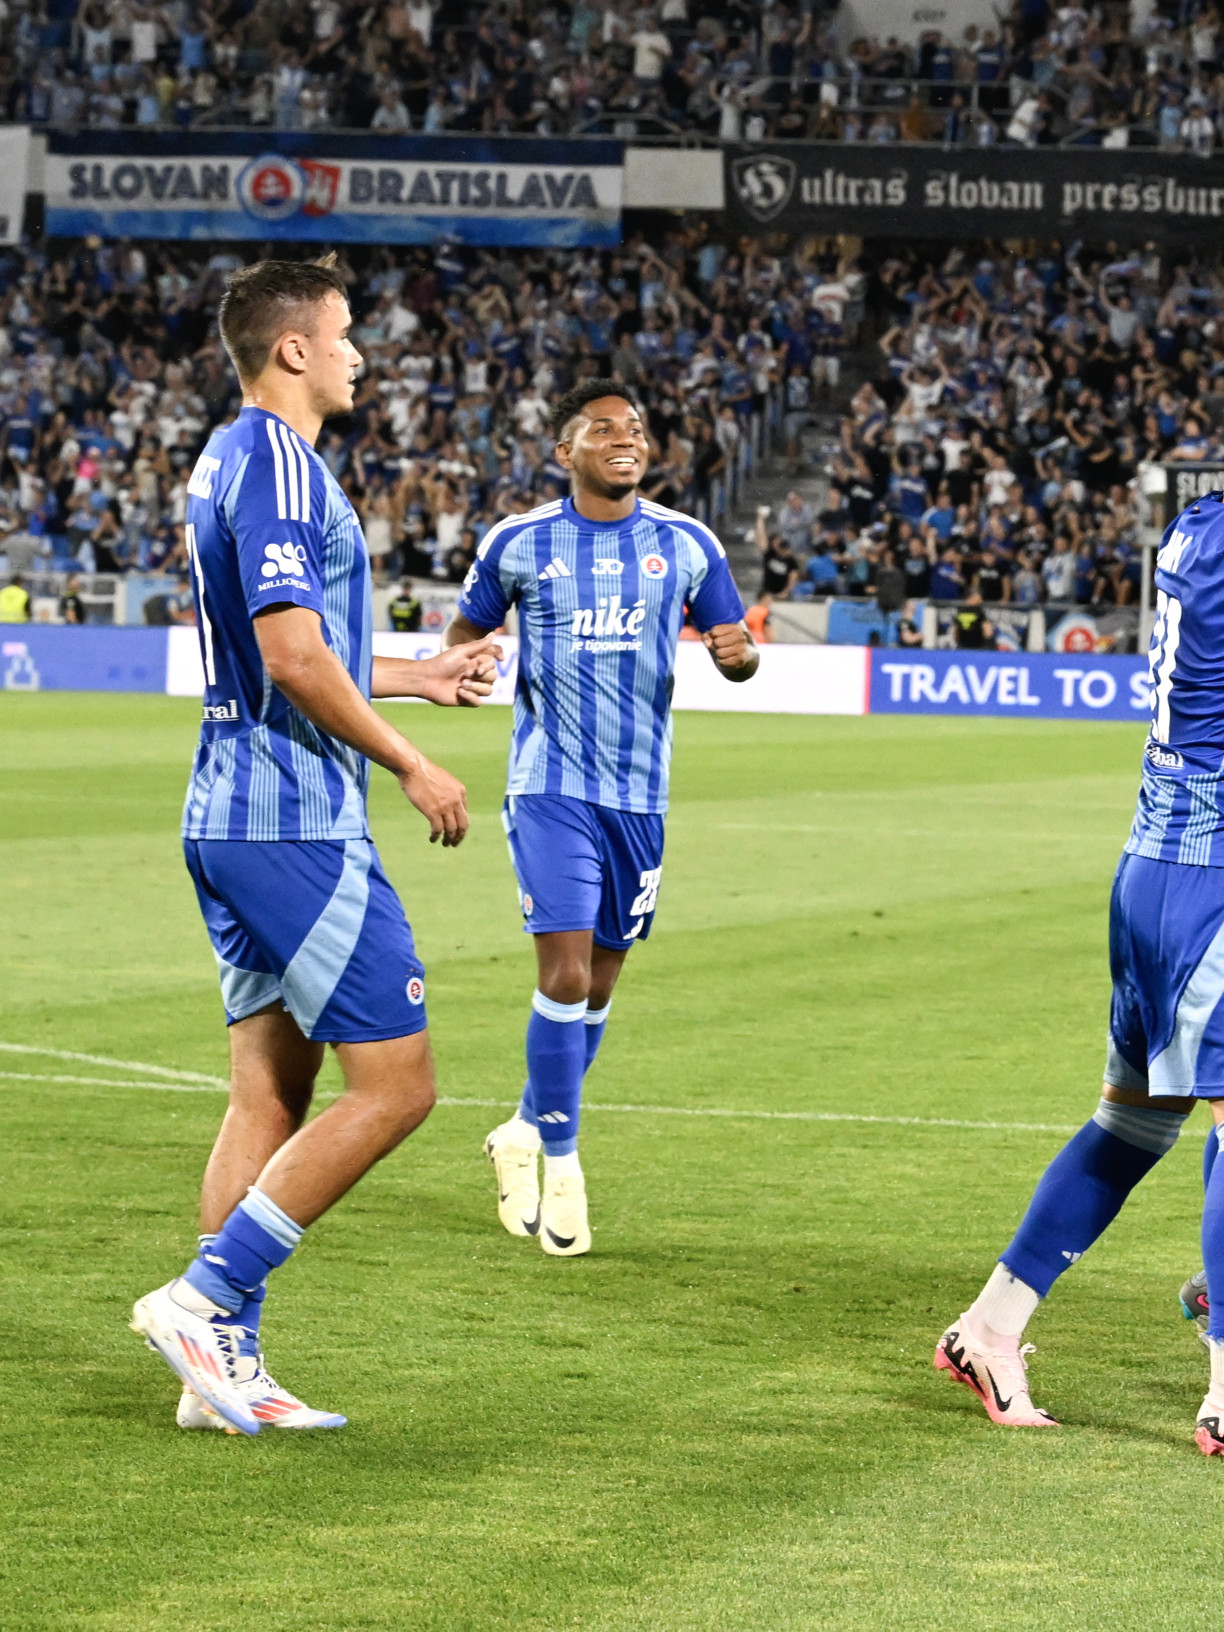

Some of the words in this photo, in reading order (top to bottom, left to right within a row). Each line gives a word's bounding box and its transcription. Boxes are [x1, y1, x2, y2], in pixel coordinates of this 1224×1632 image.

[69, 162, 230, 201] SLOVAN
[348, 167, 598, 209] BRATISLAVA
[801, 168, 906, 206] ultras
[924, 171, 1043, 212] slovan
[571, 595, 646, 636] niké
[570, 639, 583, 653] je
[585, 638, 642, 653] tipovanie
[881, 663, 1040, 705] TRAVEL
[1054, 669, 1116, 708] TO
[1130, 671, 1151, 710] S
